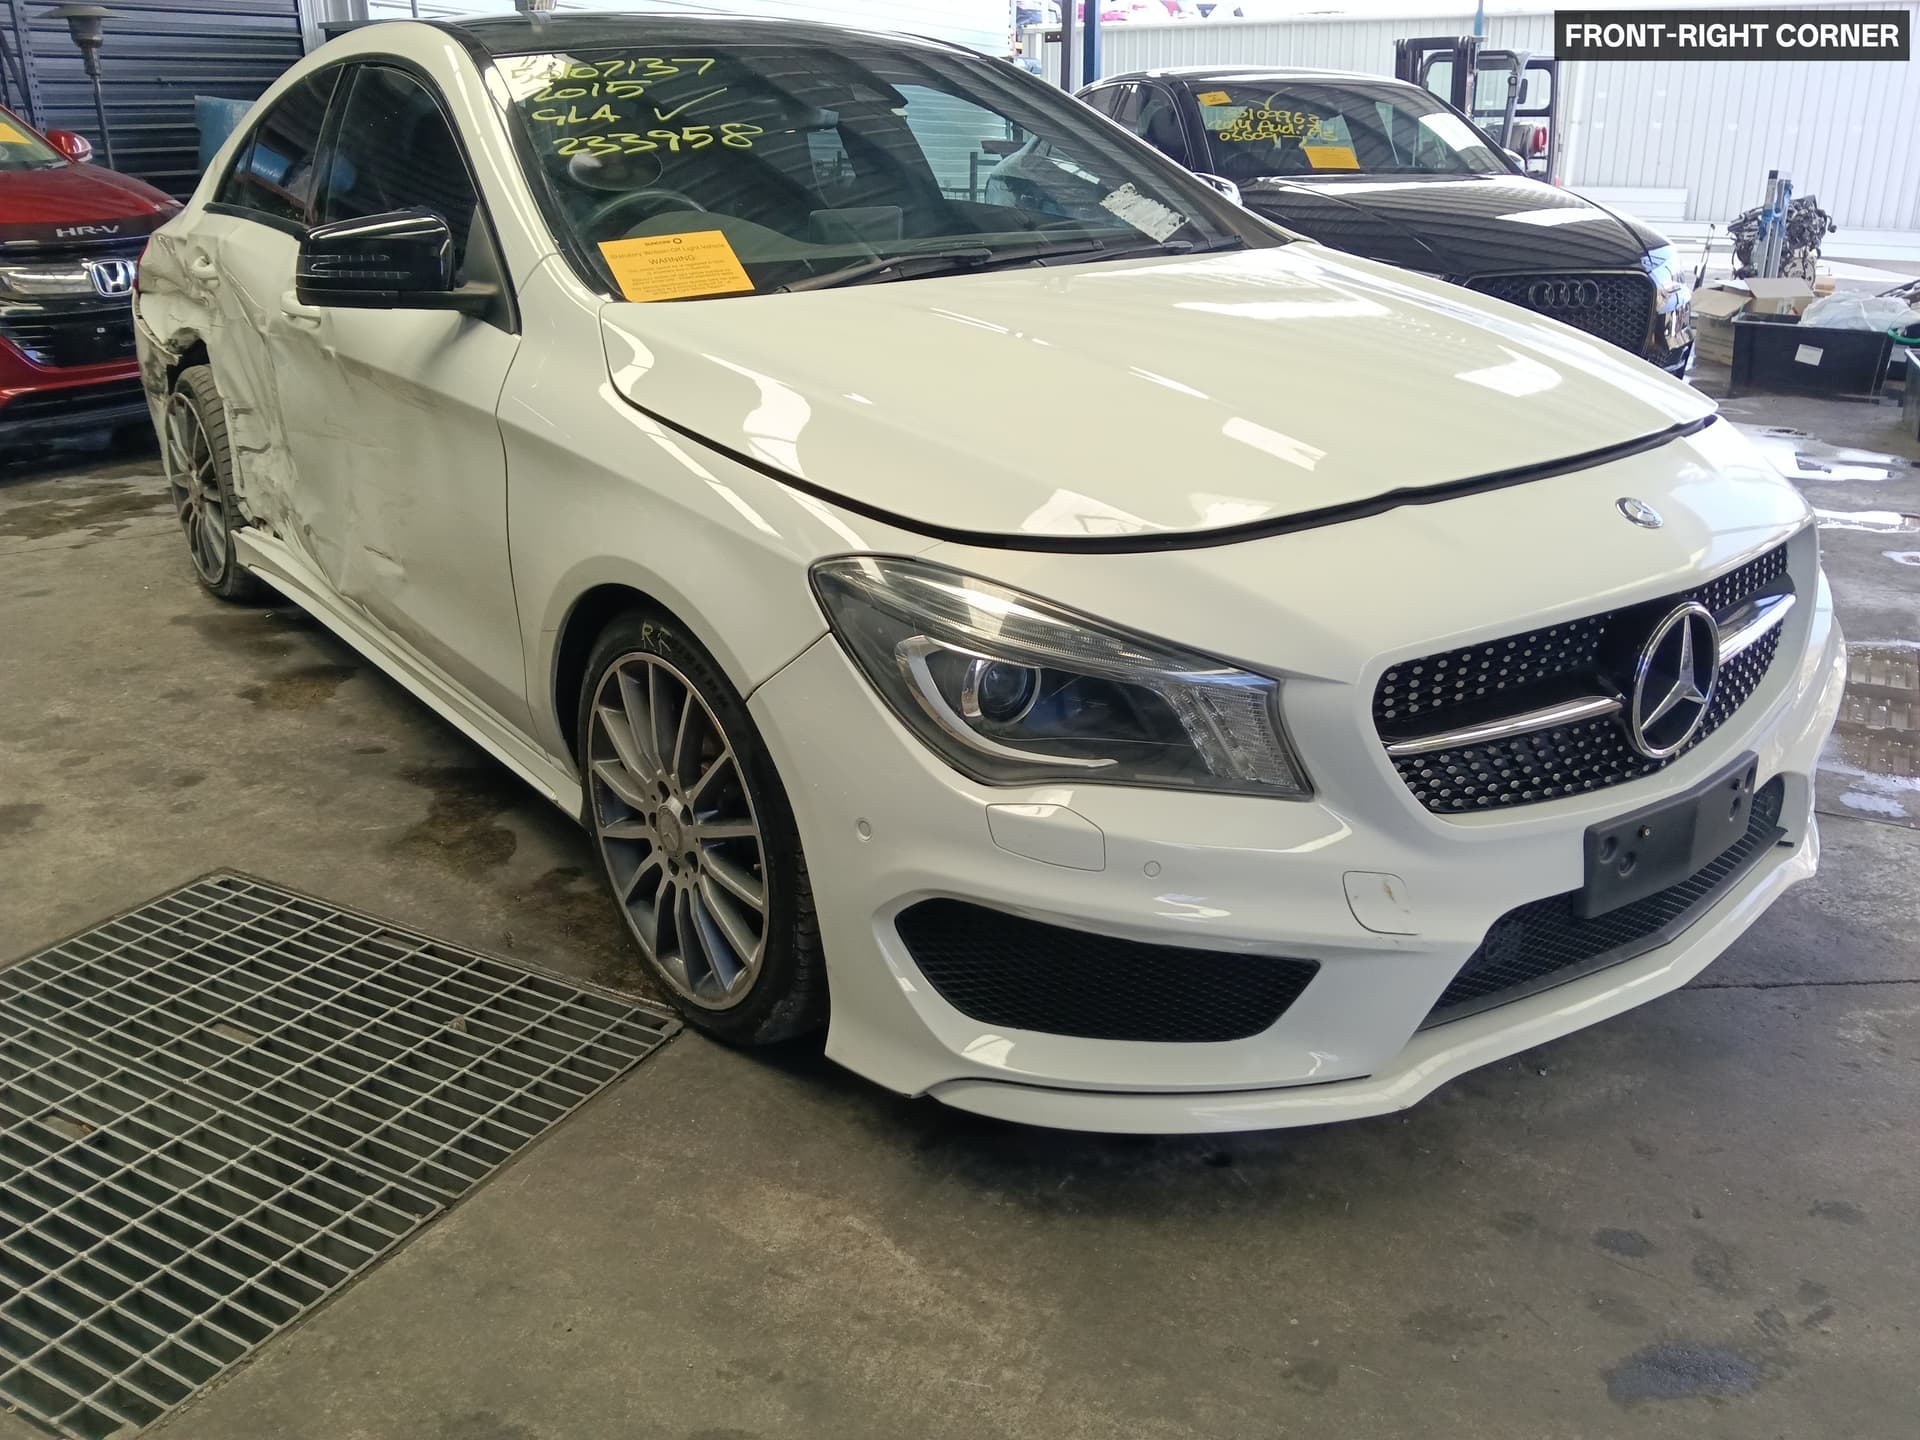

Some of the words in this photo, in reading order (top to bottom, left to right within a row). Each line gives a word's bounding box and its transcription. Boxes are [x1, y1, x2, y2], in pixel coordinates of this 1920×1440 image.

[522, 79, 653, 102] 2015
[1257, 120, 1305, 135] Audi
[553, 123, 764, 157] 233958
[55, 225, 119, 238] HR-V
[648, 254, 696, 266] WARNING
